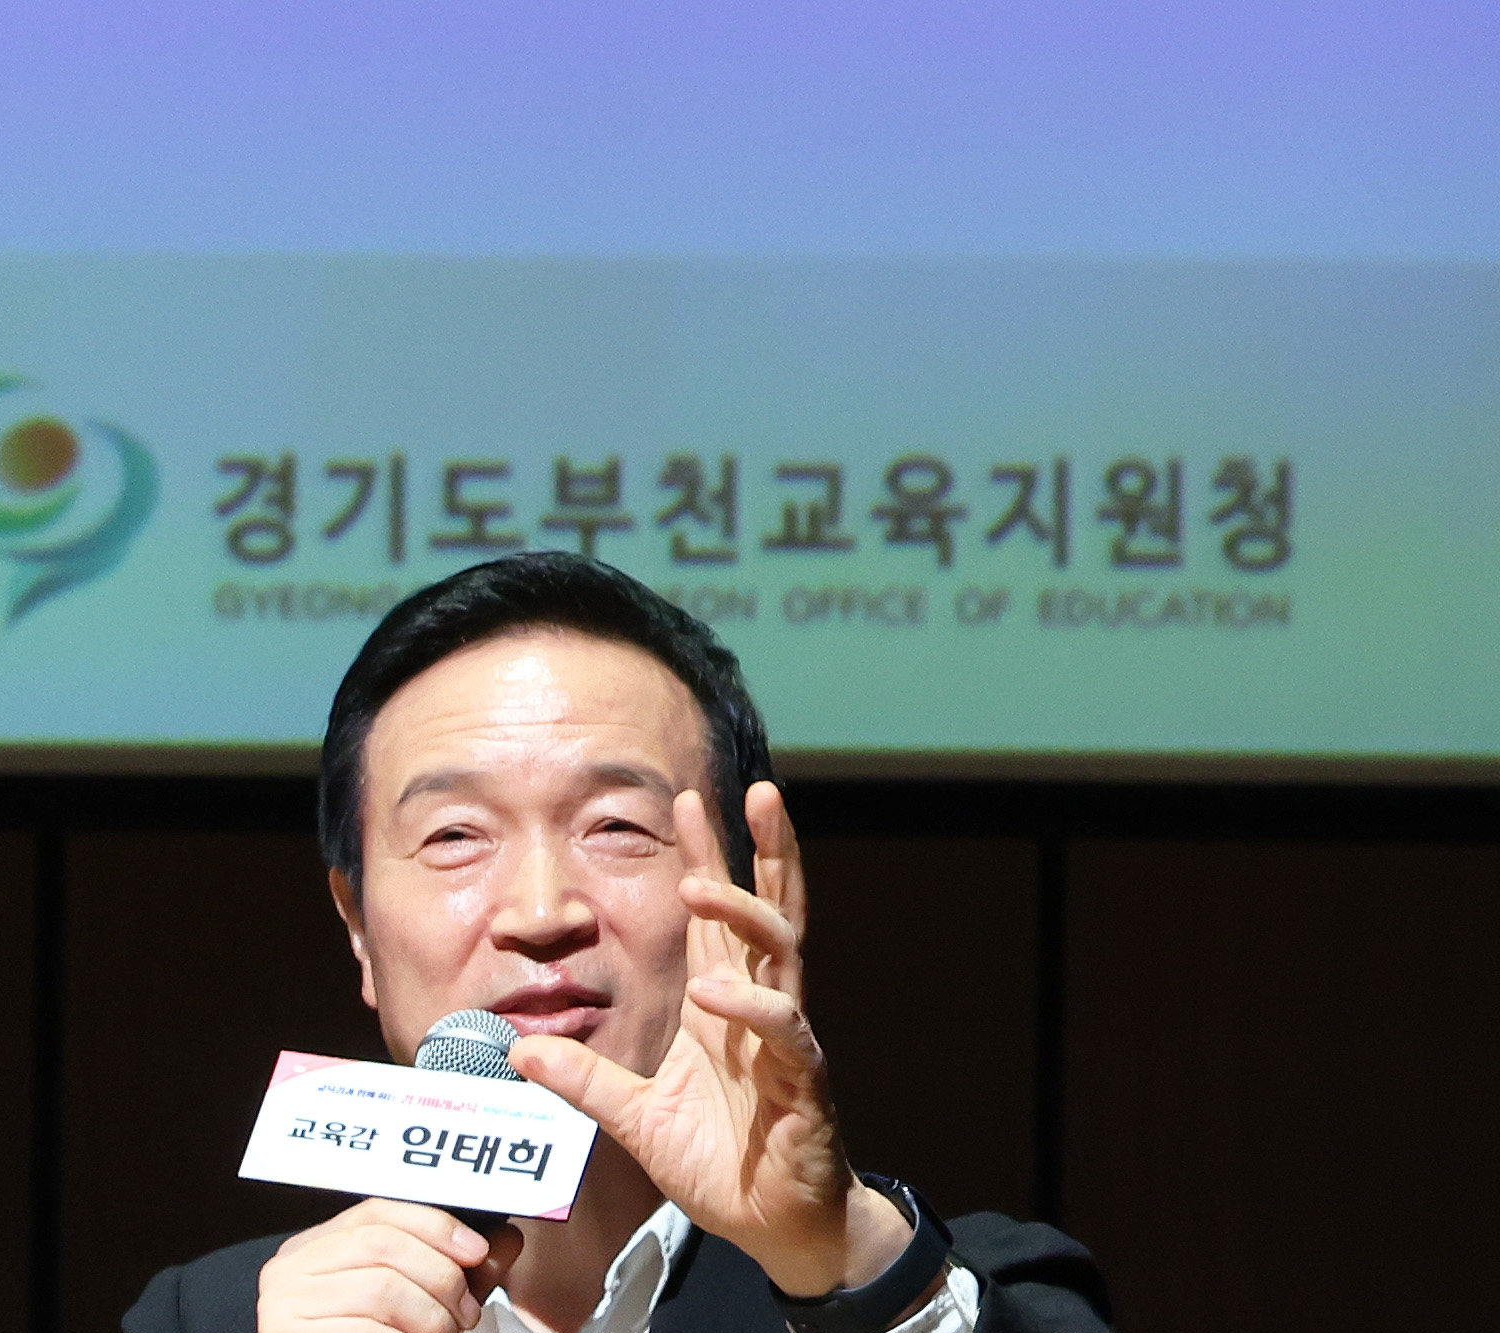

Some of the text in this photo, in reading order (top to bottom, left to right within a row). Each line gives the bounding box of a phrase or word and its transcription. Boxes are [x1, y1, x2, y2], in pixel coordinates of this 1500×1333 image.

[211, 453, 1298, 571] 경기도부천교육지원청
[212, 582, 396, 622] GYEONG
[287, 1117, 552, 1181] 교육감 임태희
